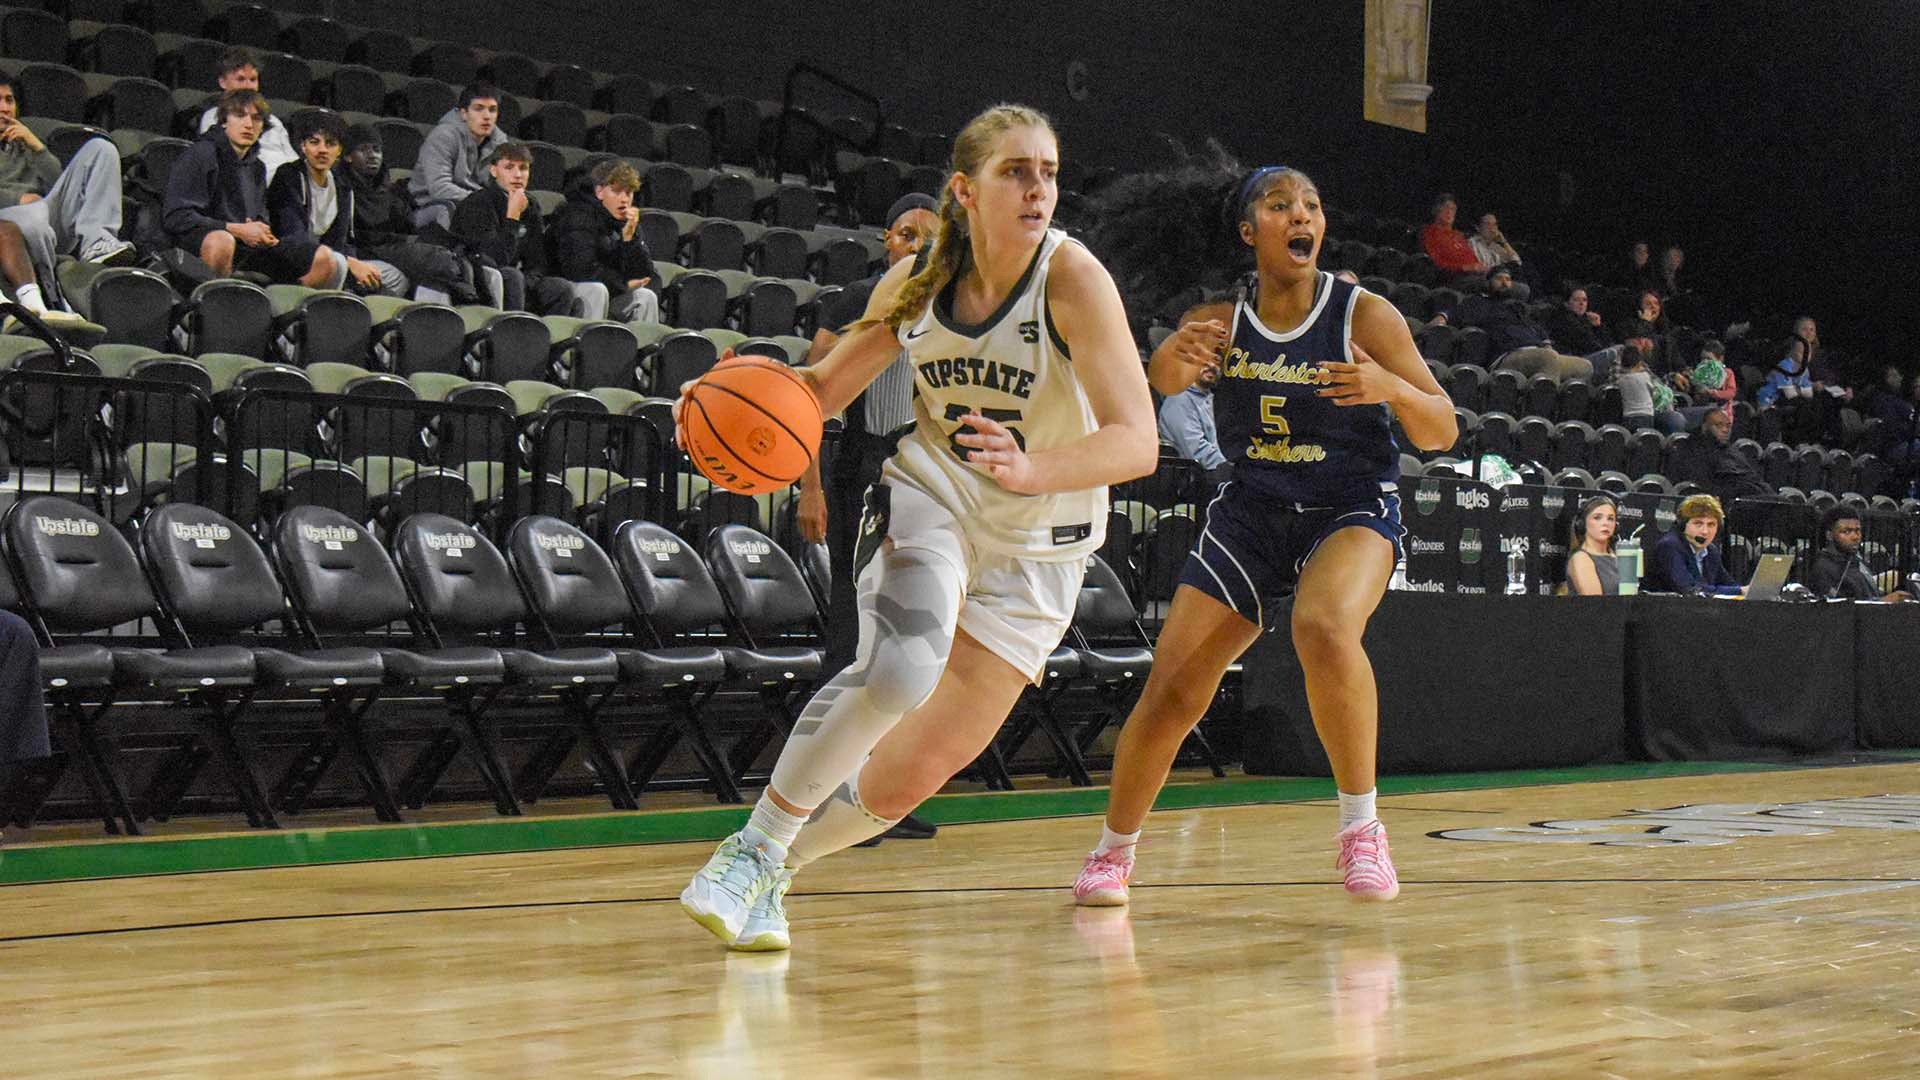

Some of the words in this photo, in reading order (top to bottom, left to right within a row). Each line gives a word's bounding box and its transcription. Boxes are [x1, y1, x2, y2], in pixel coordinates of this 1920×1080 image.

[919, 357, 1036, 399] UPSTATE
[1260, 395, 1290, 434] 5
[1456, 486, 1490, 510] ingles
[36, 516, 99, 537] Upstate
[172, 521, 231, 542] Upstate
[305, 524, 358, 544] Upstate
[424, 532, 476, 550] Upstate
[537, 533, 585, 550] Upstate
[638, 538, 681, 554] Upstate
[730, 540, 771, 555] Upstate
